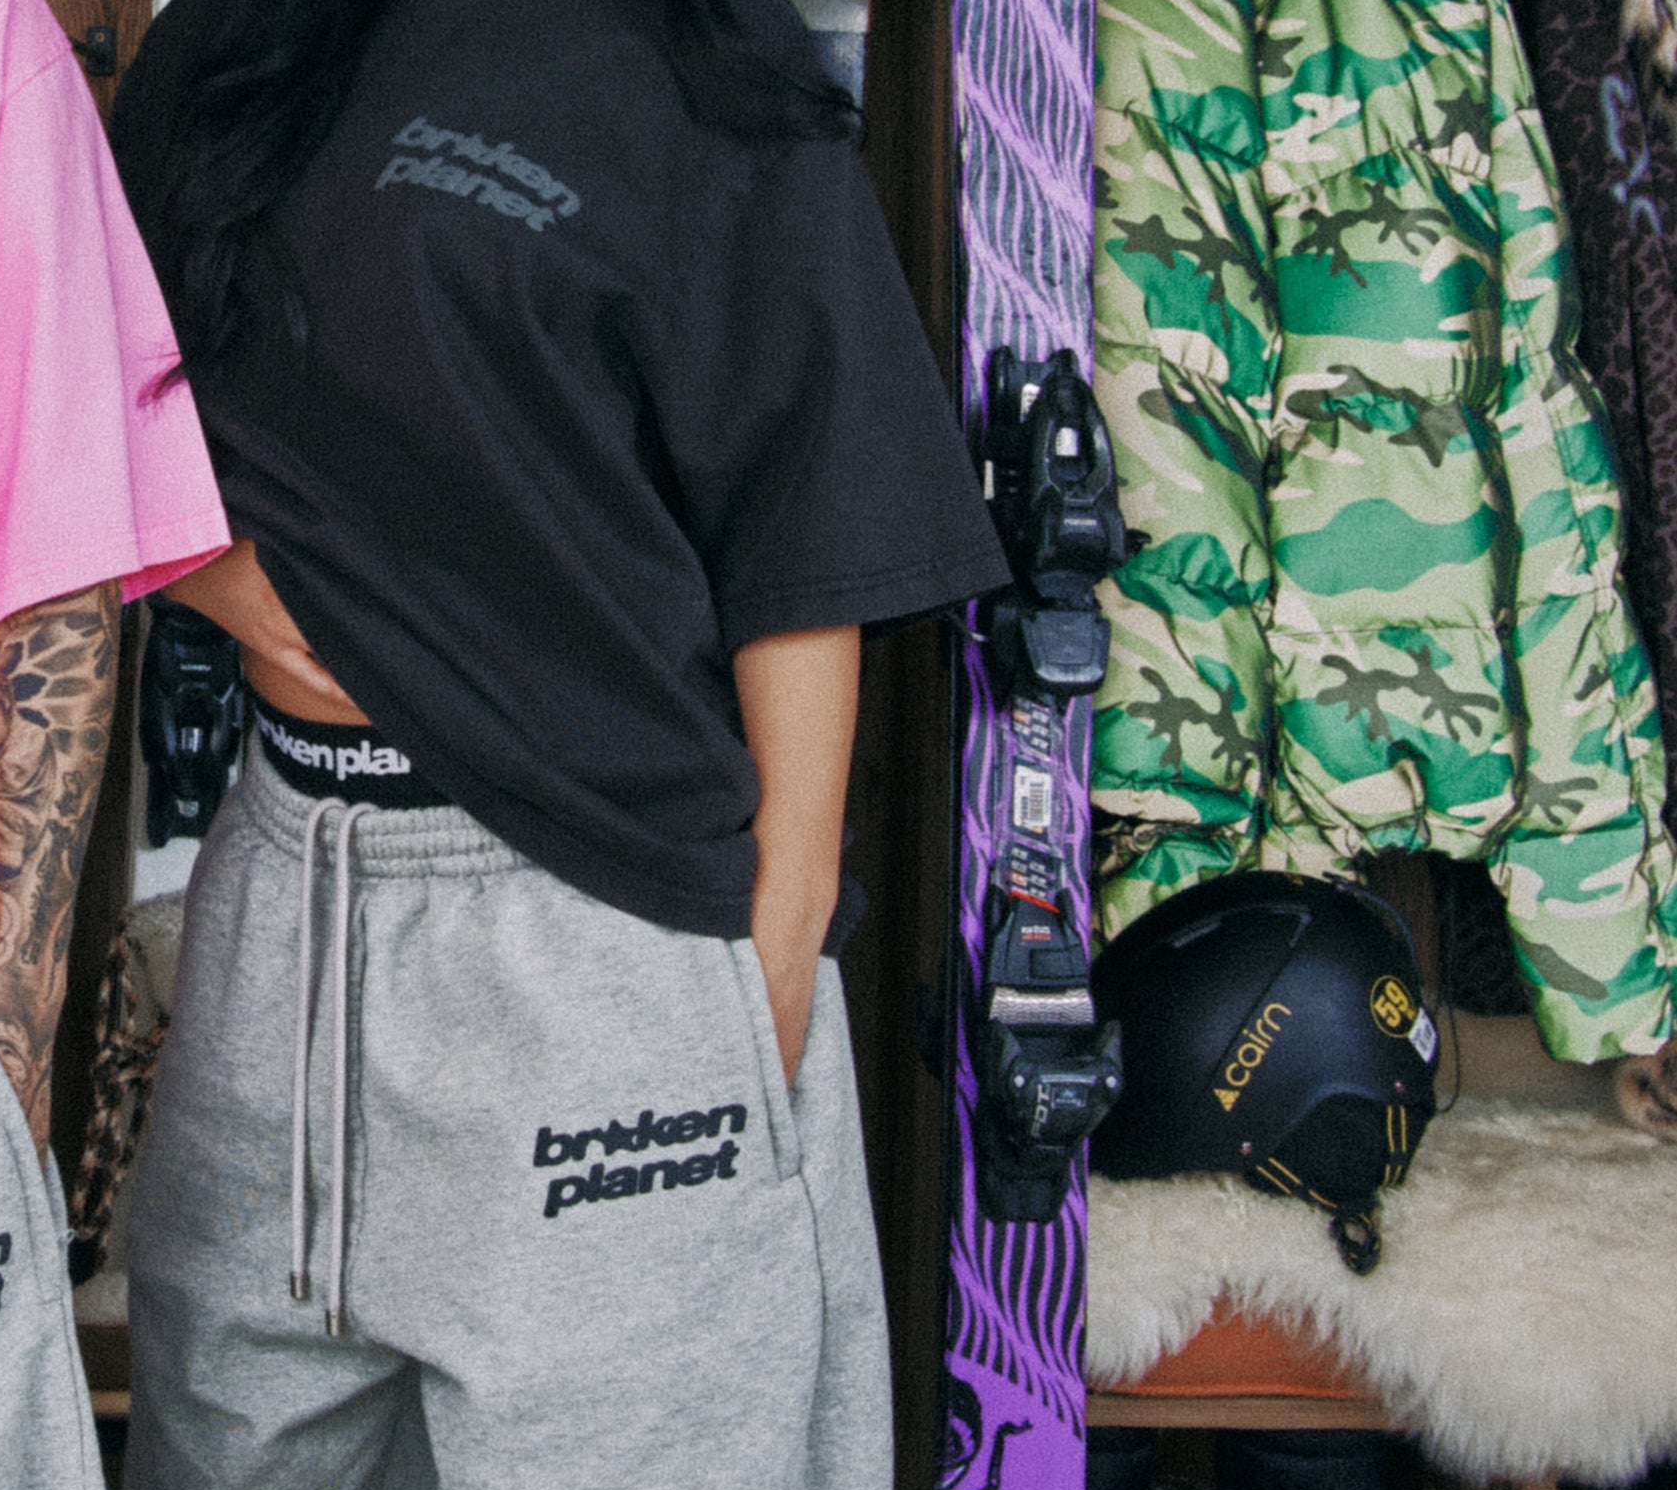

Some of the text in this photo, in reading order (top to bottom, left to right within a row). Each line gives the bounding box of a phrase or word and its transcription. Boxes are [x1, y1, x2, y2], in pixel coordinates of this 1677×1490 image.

[375, 155, 557, 233] planet
[1225, 1002, 1293, 1088] cairn
[543, 1140, 740, 1218] planet
